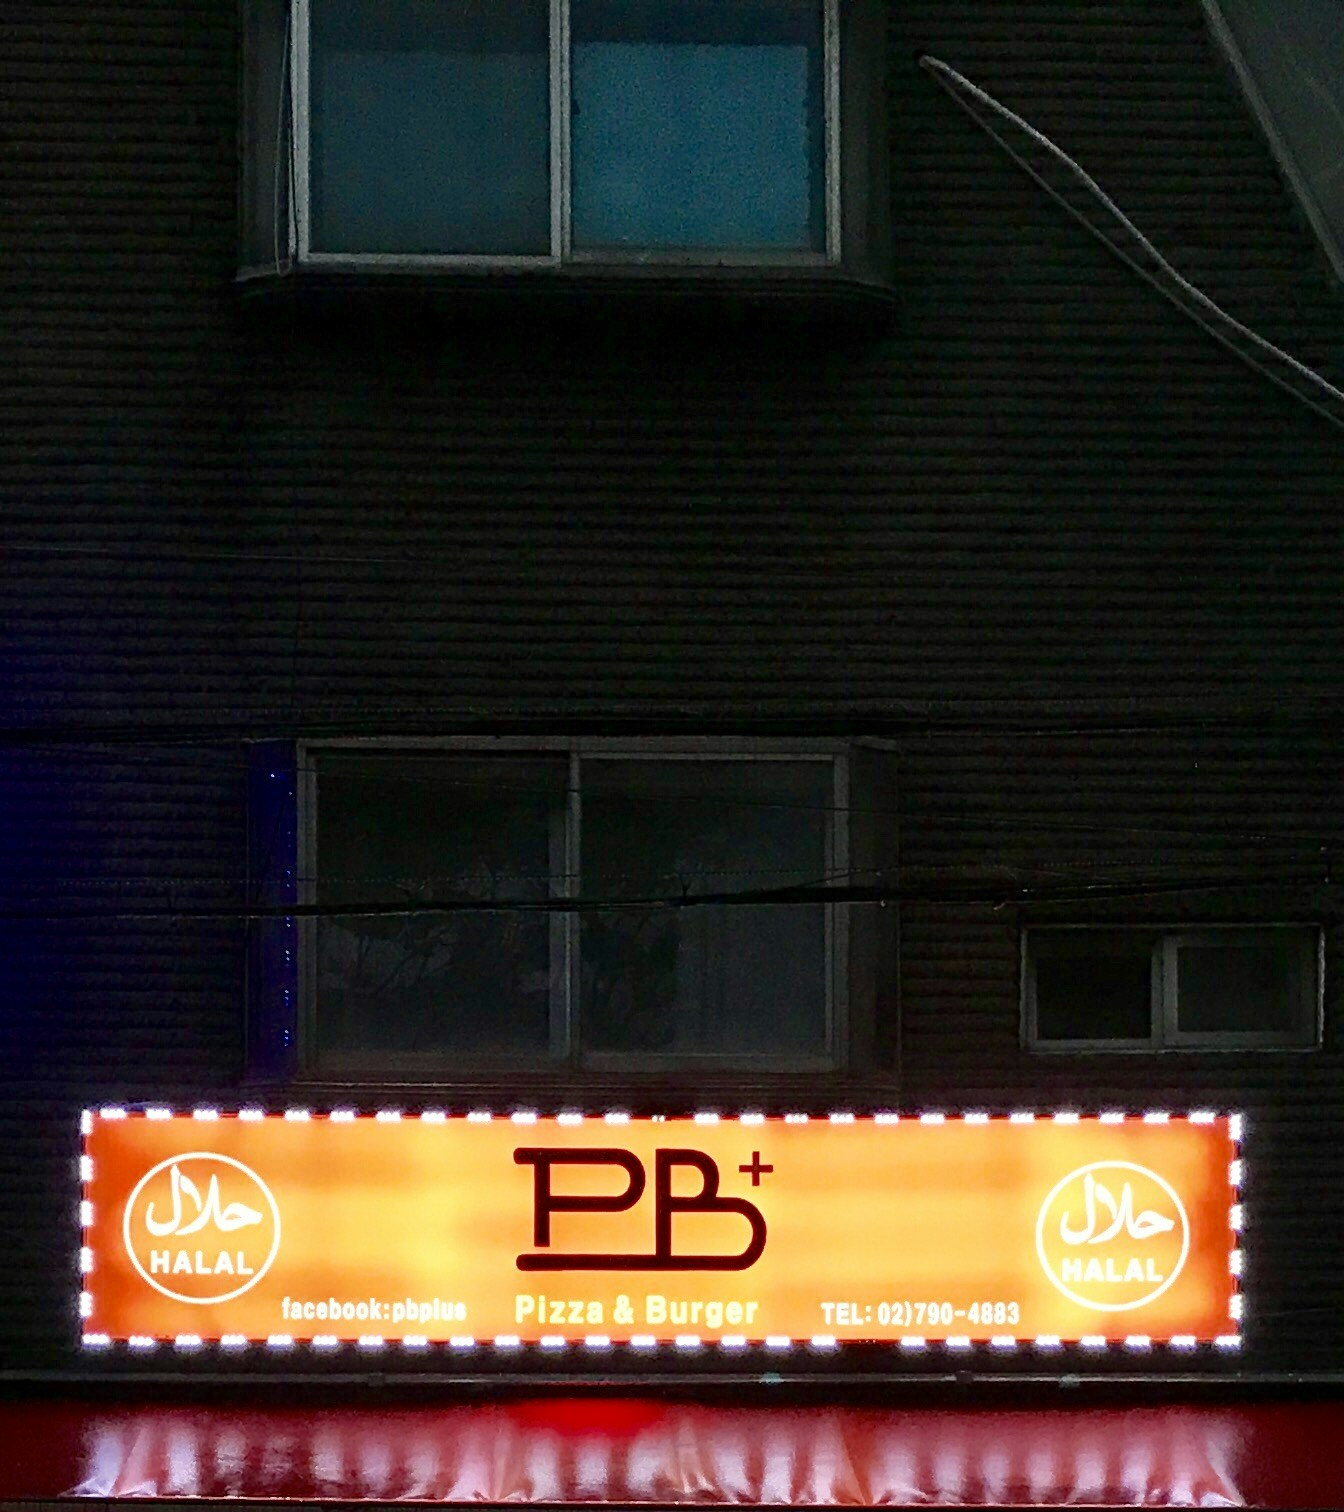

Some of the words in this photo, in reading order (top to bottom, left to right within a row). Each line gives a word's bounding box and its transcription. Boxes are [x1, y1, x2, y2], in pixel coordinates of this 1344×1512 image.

[145, 1163, 263, 1237] حلال
[1059, 1172, 1175, 1245] حلال
[150, 1250, 254, 1275] HALAL
[1061, 1258, 1164, 1283] HALAL
[515, 1294, 604, 1325] Pizza
[613, 1294, 635, 1325] &
[645, 1294, 759, 1328] Burger
[821, 1302, 872, 1326] TEL:
[877, 1301, 1020, 1327] 02)790-4883
